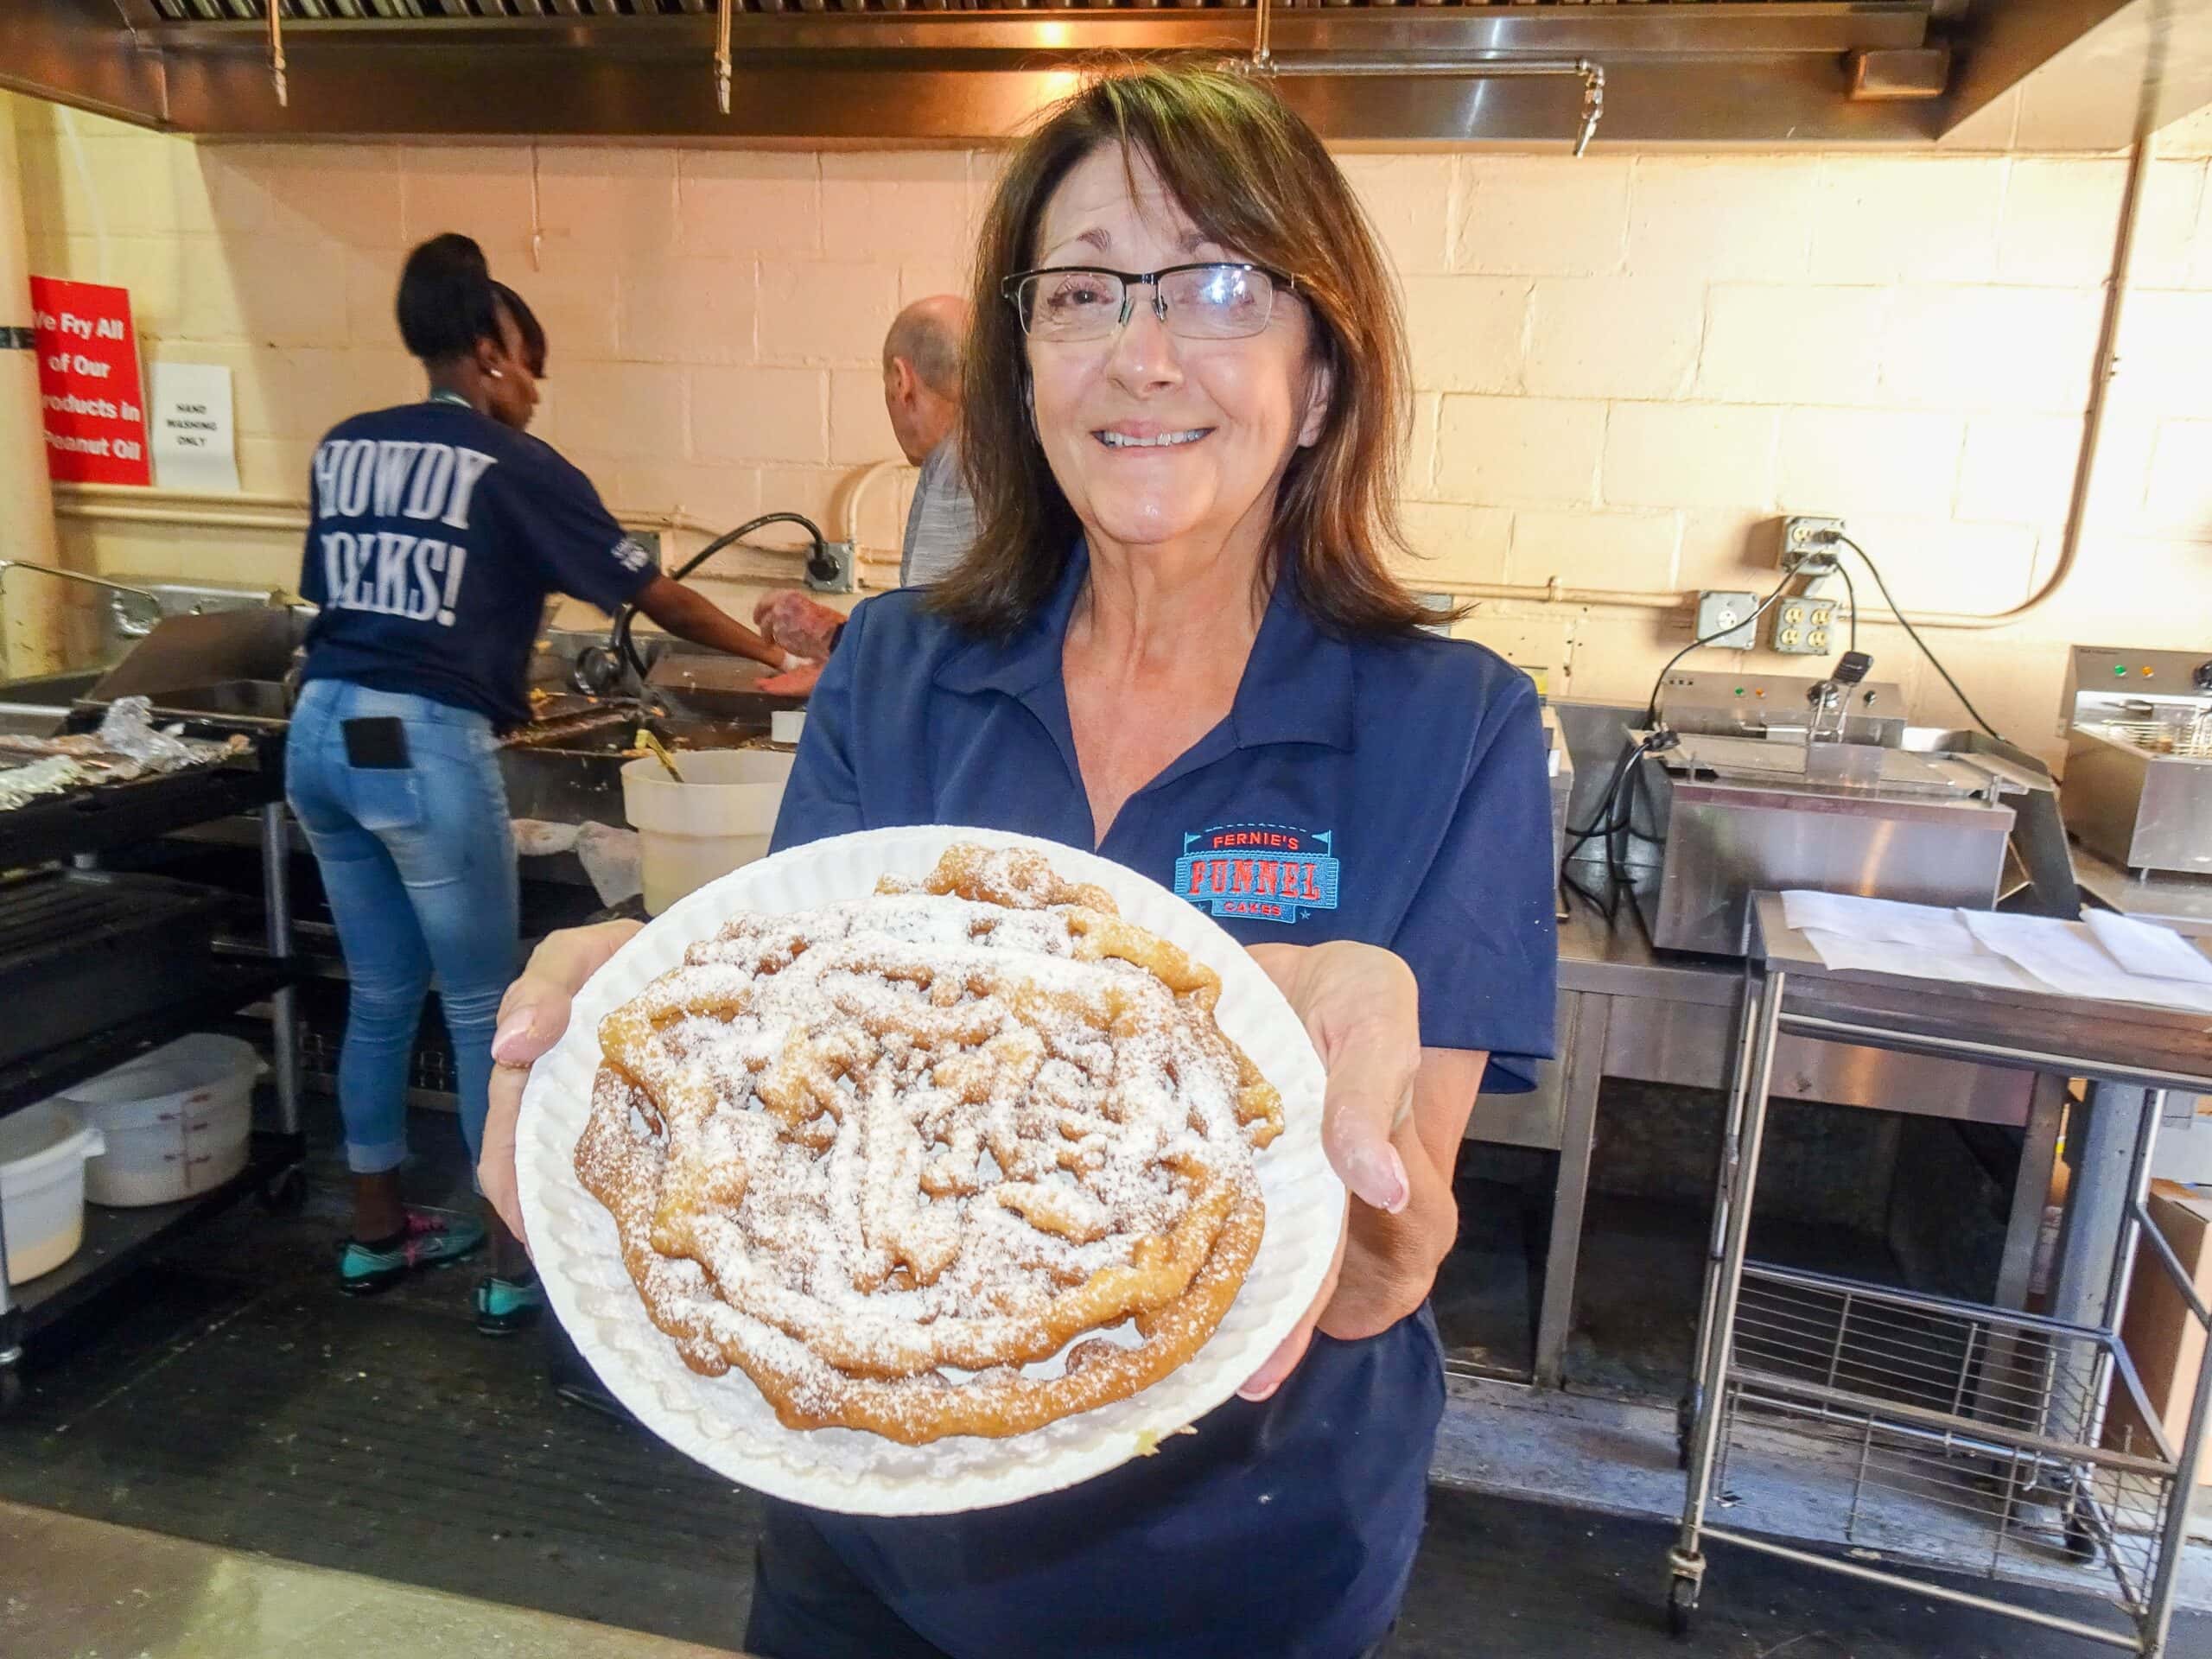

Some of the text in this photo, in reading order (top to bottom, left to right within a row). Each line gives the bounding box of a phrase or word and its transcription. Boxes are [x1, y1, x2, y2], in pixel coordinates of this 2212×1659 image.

[60, 312, 92, 340] Fry
[96, 318, 124, 340] All
[48, 353, 111, 378] of Our
[41, 393, 140, 422] roducts in
[112, 438, 141, 461] Oil
[177, 435, 206, 447] ONLY
[313, 440, 499, 530] HOWDY
[1213, 831, 1300, 850] FERNIE'S
[1188, 858, 1320, 900] FUNNEL
[1223, 901, 1281, 916] CAKES
